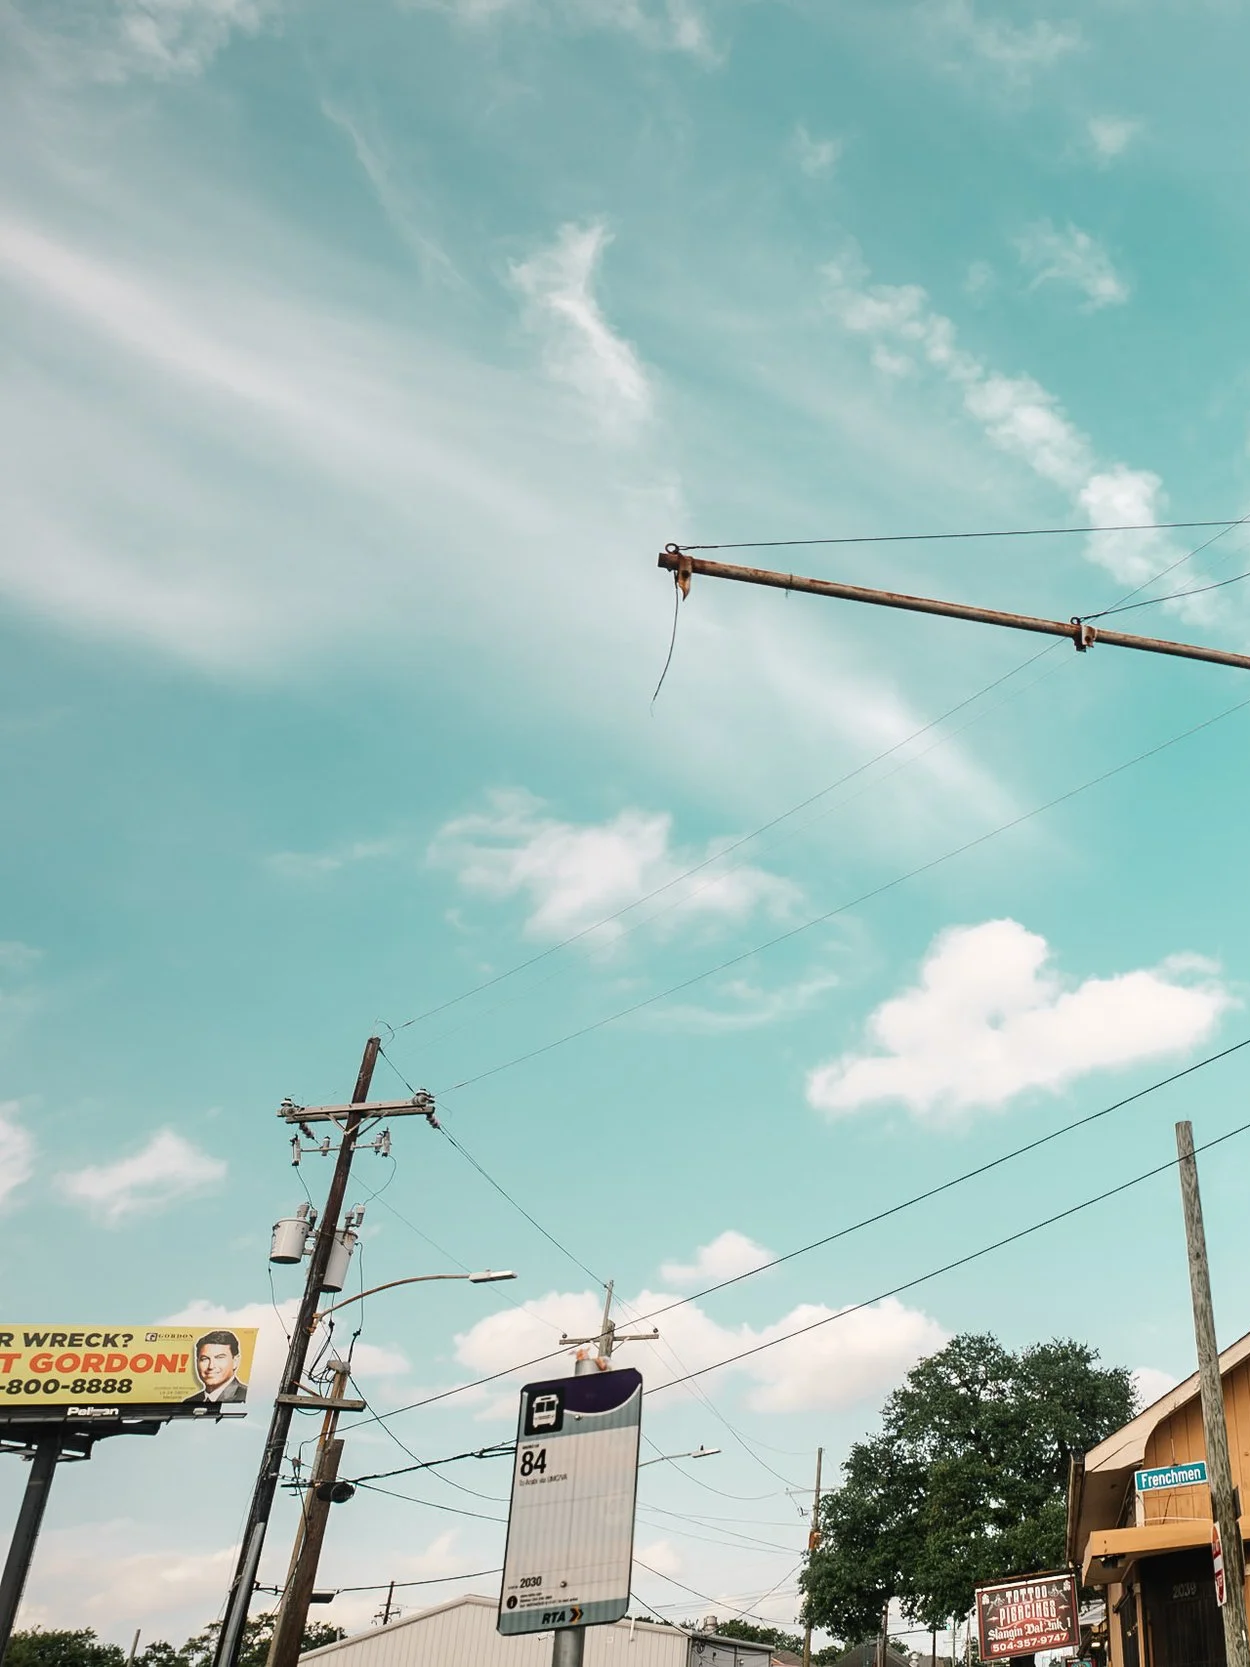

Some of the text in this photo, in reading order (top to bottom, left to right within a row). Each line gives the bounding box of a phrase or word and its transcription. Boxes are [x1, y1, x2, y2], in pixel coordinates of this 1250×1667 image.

[23, 1332, 134, 1348] WRECK?
[29, 1353, 189, 1373] GORDON!
[520, 1448, 546, 1476] 84
[1141, 1468, 1201, 1488] Frenchmen
[520, 1576, 542, 1588] 2030
[1172, 1582, 1197, 1599] 2039
[1005, 1585, 1047, 1604] TATTOO
[542, 1611, 566, 1624] RTA
[999, 1600, 1056, 1626] PIERCINGS
[987, 1624, 1023, 1641] Slangin
[992, 1632, 1067, 1652] 504-357-9747
